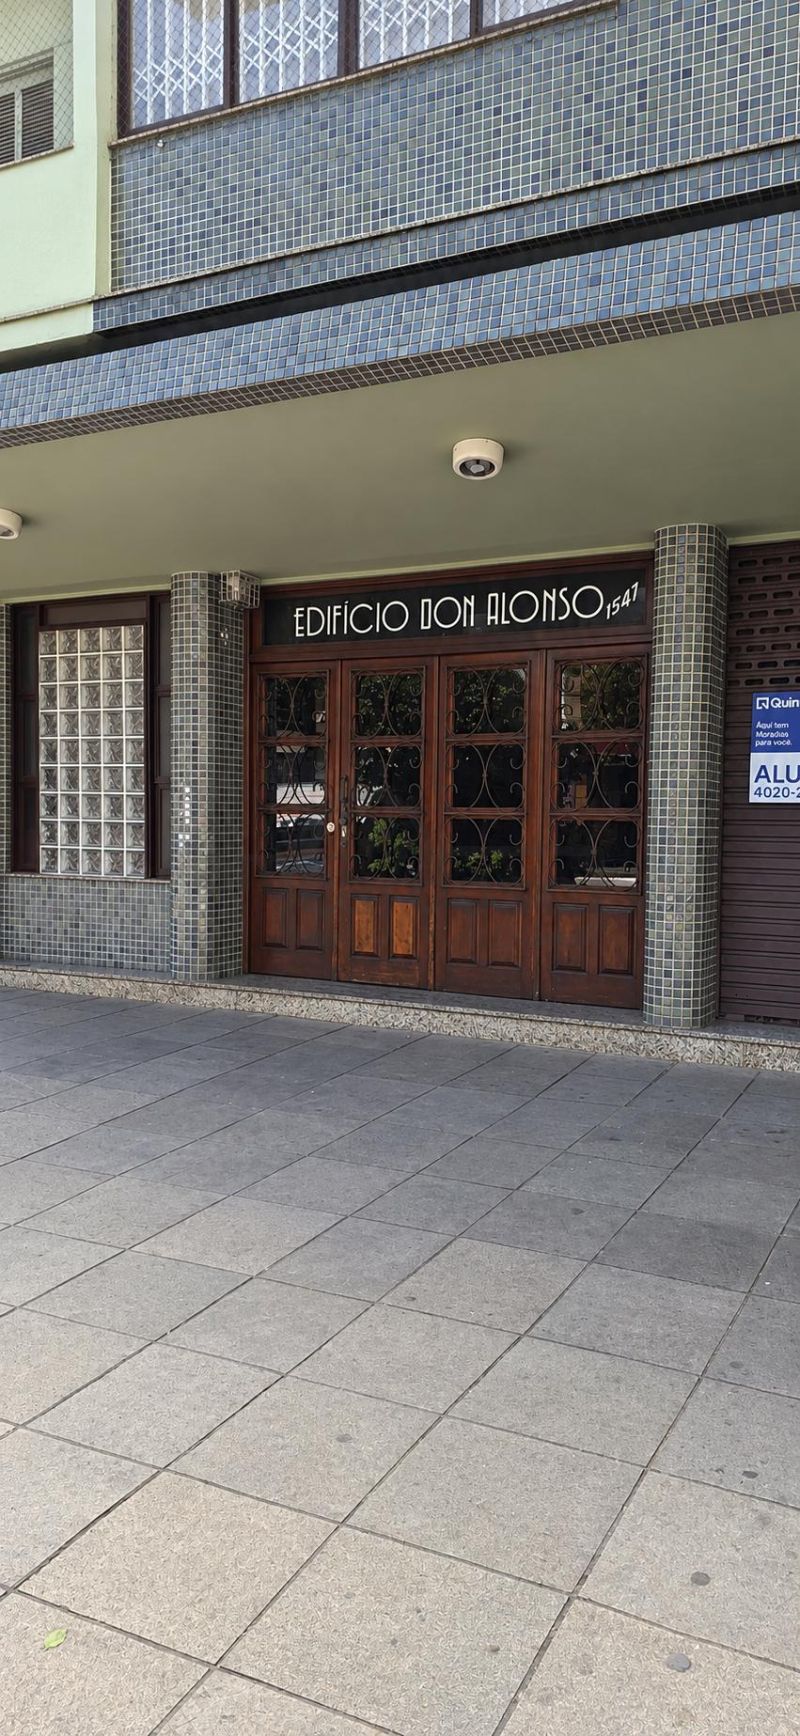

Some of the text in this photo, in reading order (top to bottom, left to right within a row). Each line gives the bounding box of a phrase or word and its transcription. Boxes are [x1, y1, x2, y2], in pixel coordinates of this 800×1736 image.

[294, 582, 640, 638] EDIFÍCIO DON ALONSO 1547
[770, 696, 800, 709] Quin
[755, 721, 773, 730] Aqui
[755, 739, 772, 747] para
[754, 764, 800, 784] ALU
